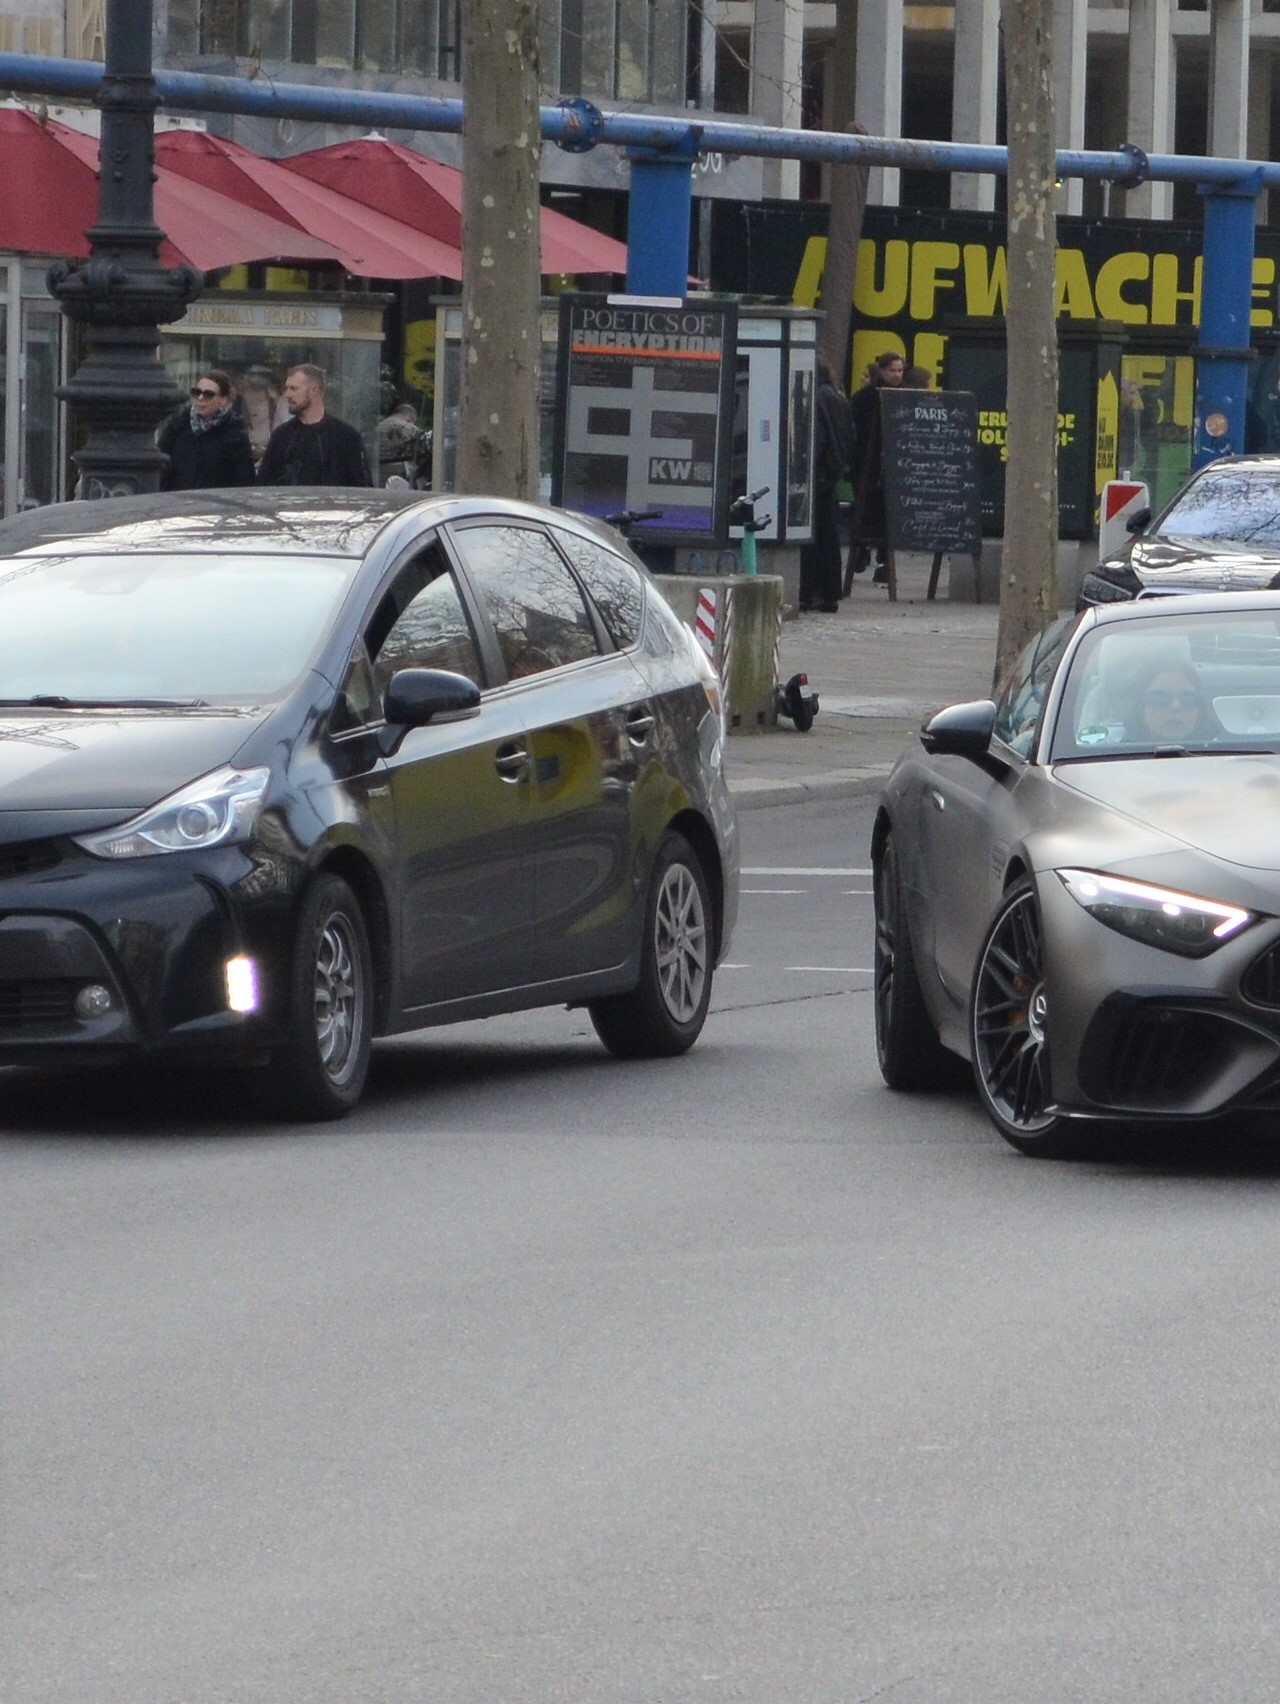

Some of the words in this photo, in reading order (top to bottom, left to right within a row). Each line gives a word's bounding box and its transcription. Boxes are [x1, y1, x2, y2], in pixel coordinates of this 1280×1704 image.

[583, 308, 678, 333] POETICS
[681, 313, 714, 335] OF
[572, 329, 722, 353] ENCRYPTION
[914, 406, 948, 421] PARIS
[650, 458, 692, 481] KW
